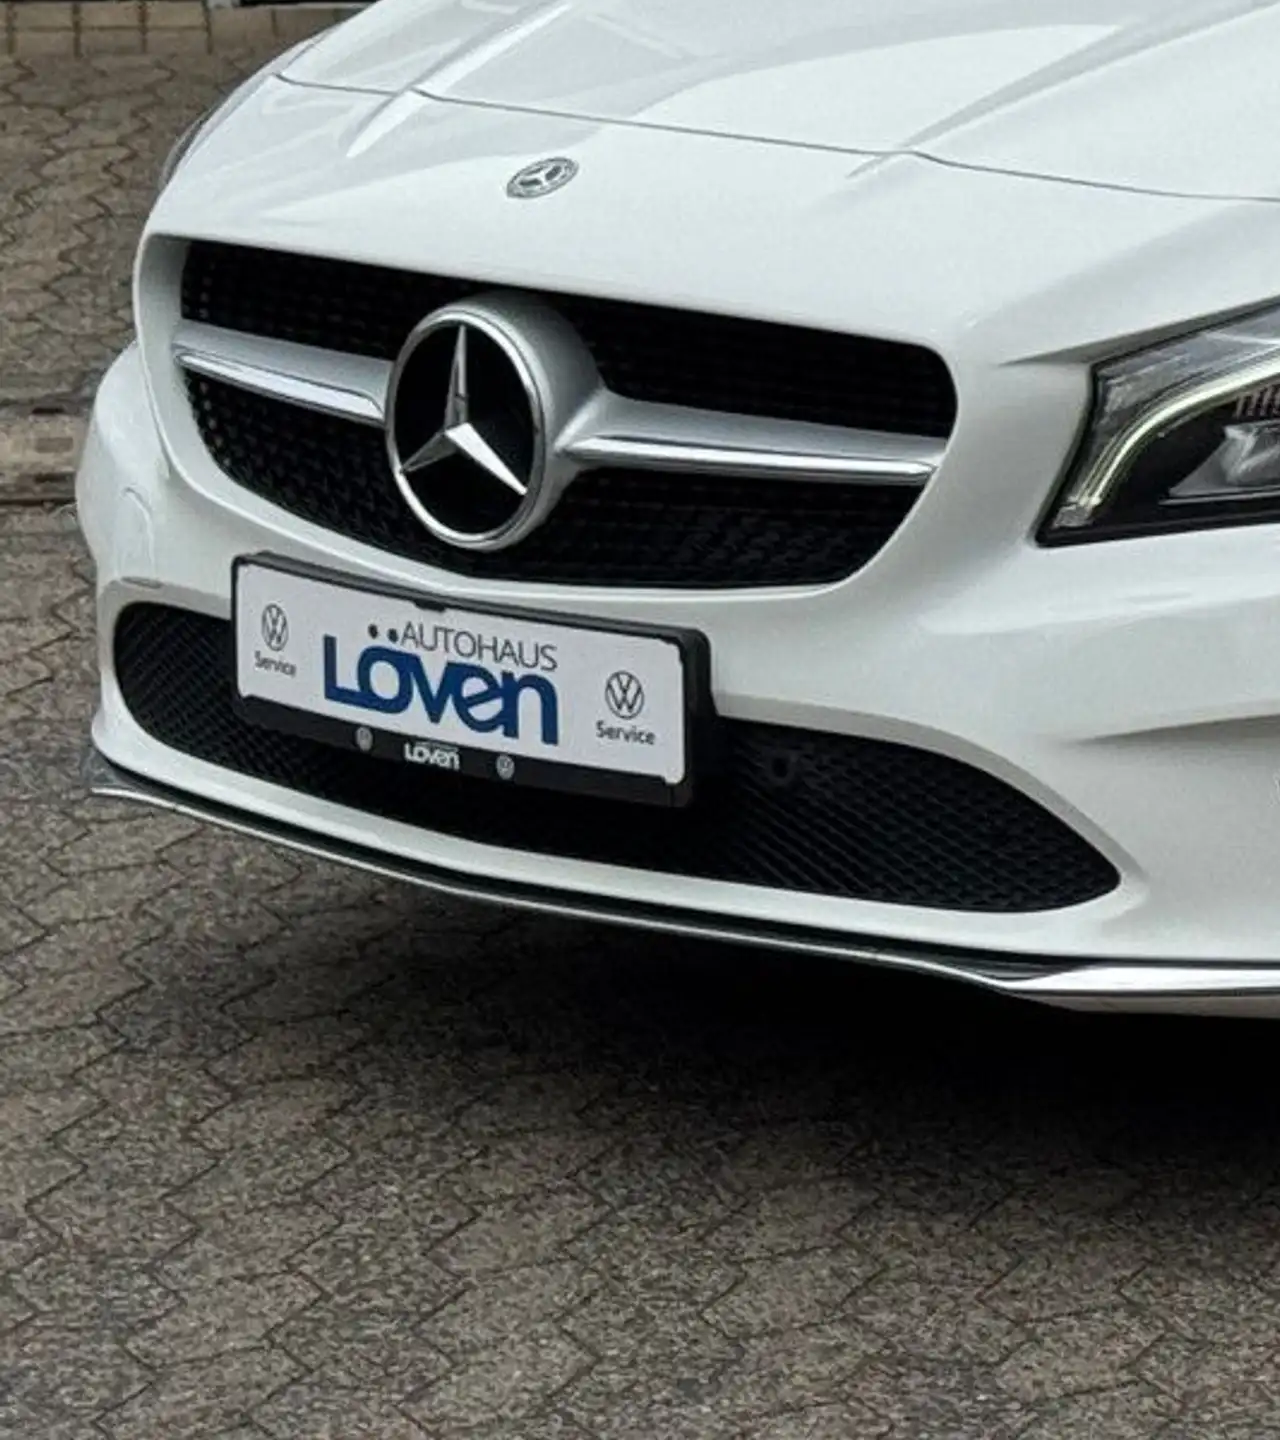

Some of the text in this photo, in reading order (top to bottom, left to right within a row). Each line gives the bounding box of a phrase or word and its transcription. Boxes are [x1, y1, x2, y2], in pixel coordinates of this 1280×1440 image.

[255, 650, 297, 677] Service
[401, 621, 558, 673] AUTOHAUS
[323, 624, 559, 746] Löven
[596, 720, 656, 746] Service
